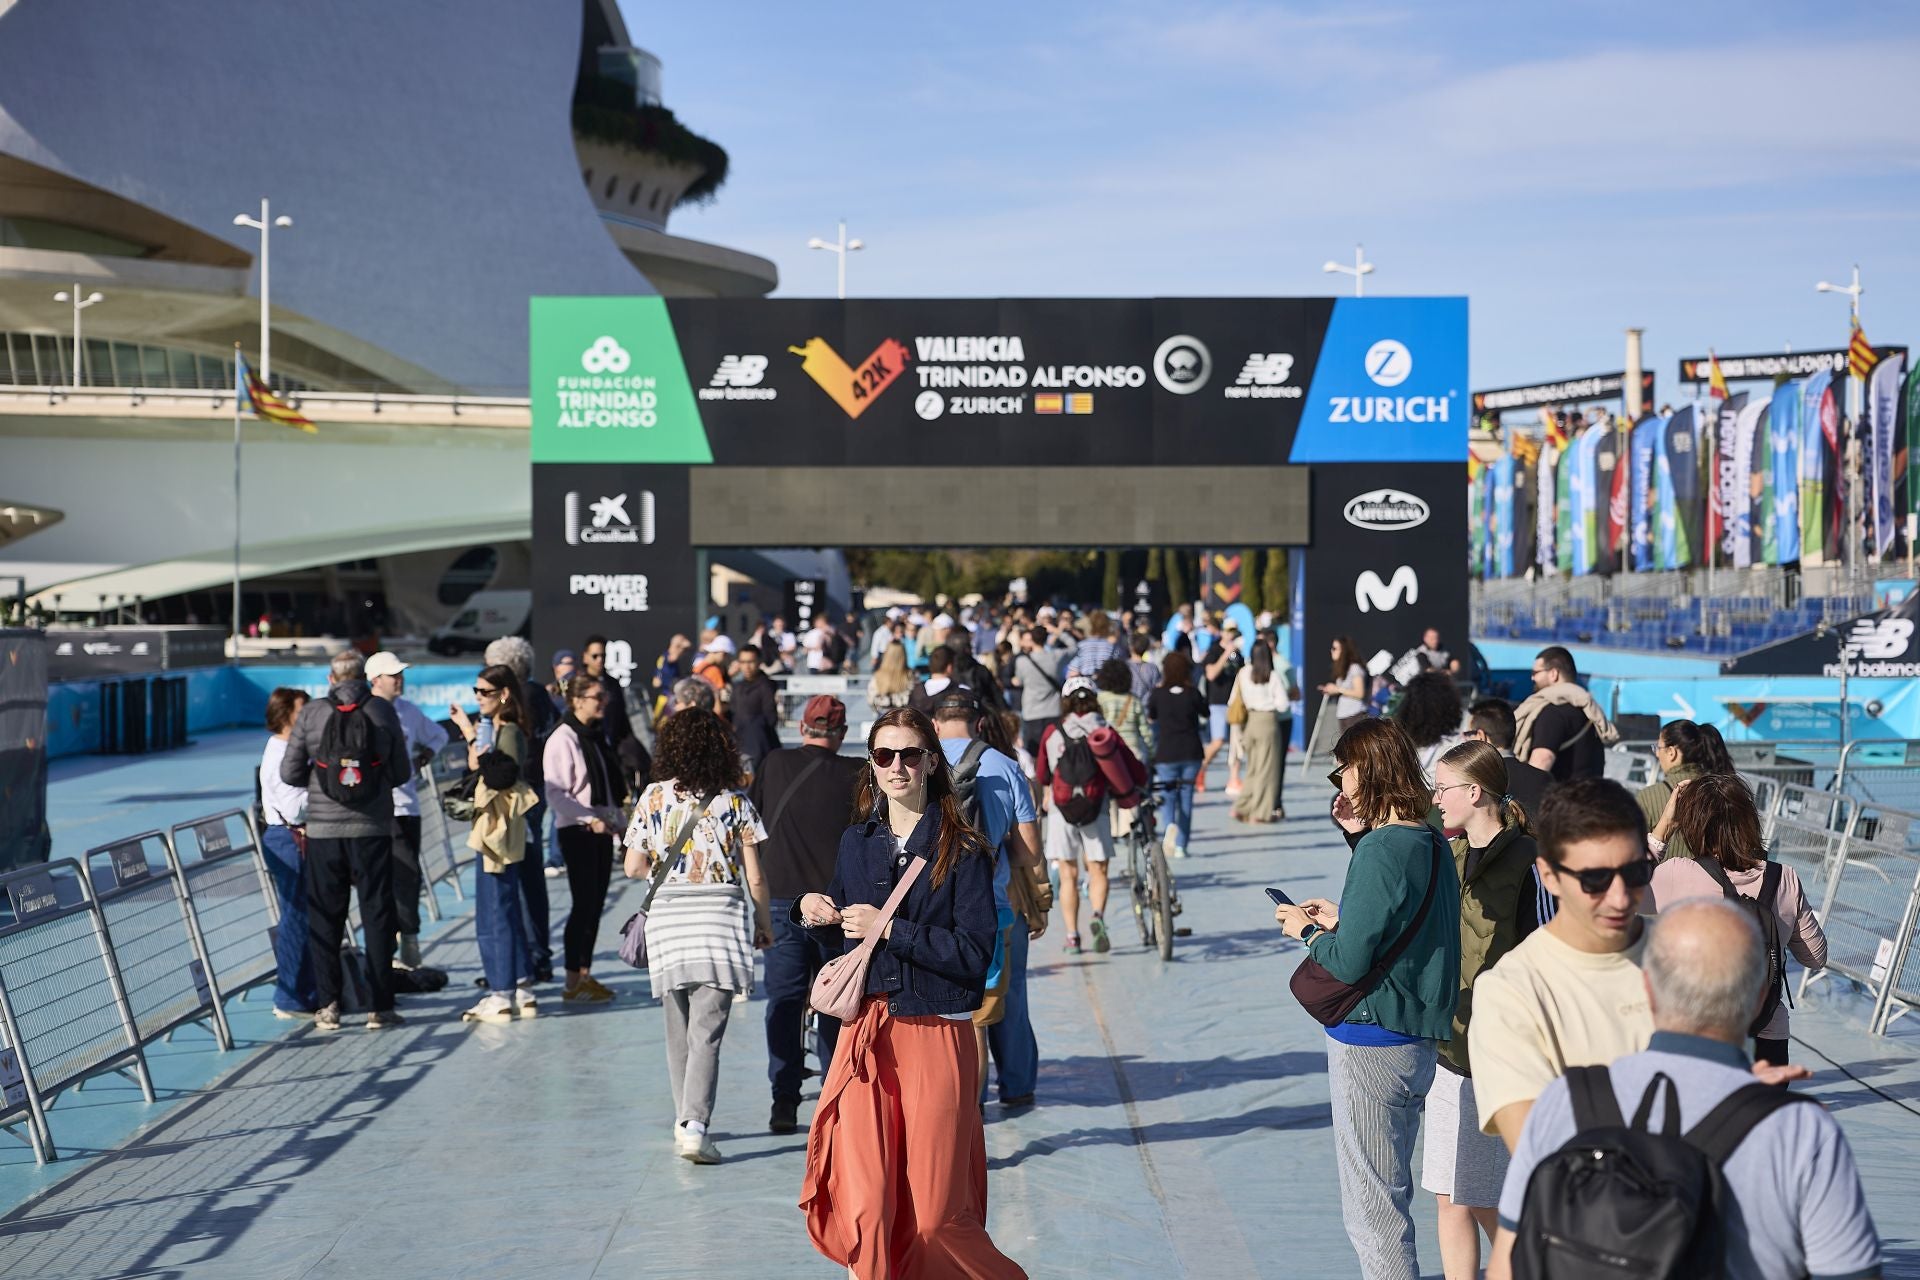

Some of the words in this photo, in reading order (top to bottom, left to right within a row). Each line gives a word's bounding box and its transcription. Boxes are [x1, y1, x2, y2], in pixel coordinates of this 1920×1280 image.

[915, 336, 1025, 362] VALENCIA
[557, 374, 656, 389] FUNDACIÓN
[851, 355, 892, 401] 42K
[916, 365, 1028, 388] TRINIDAD
[1031, 365, 1147, 388] ALFONSO
[556, 390, 658, 410] TRINIDAD
[725, 386, 777, 400] balance
[1251, 385, 1303, 398] balance
[949, 397, 1023, 414] ZURICH
[1328, 396, 1450, 422] ZURICH
[557, 409, 658, 428] ALFONSO
[1720, 410, 1737, 460] new
[569, 574, 648, 594] POWER
